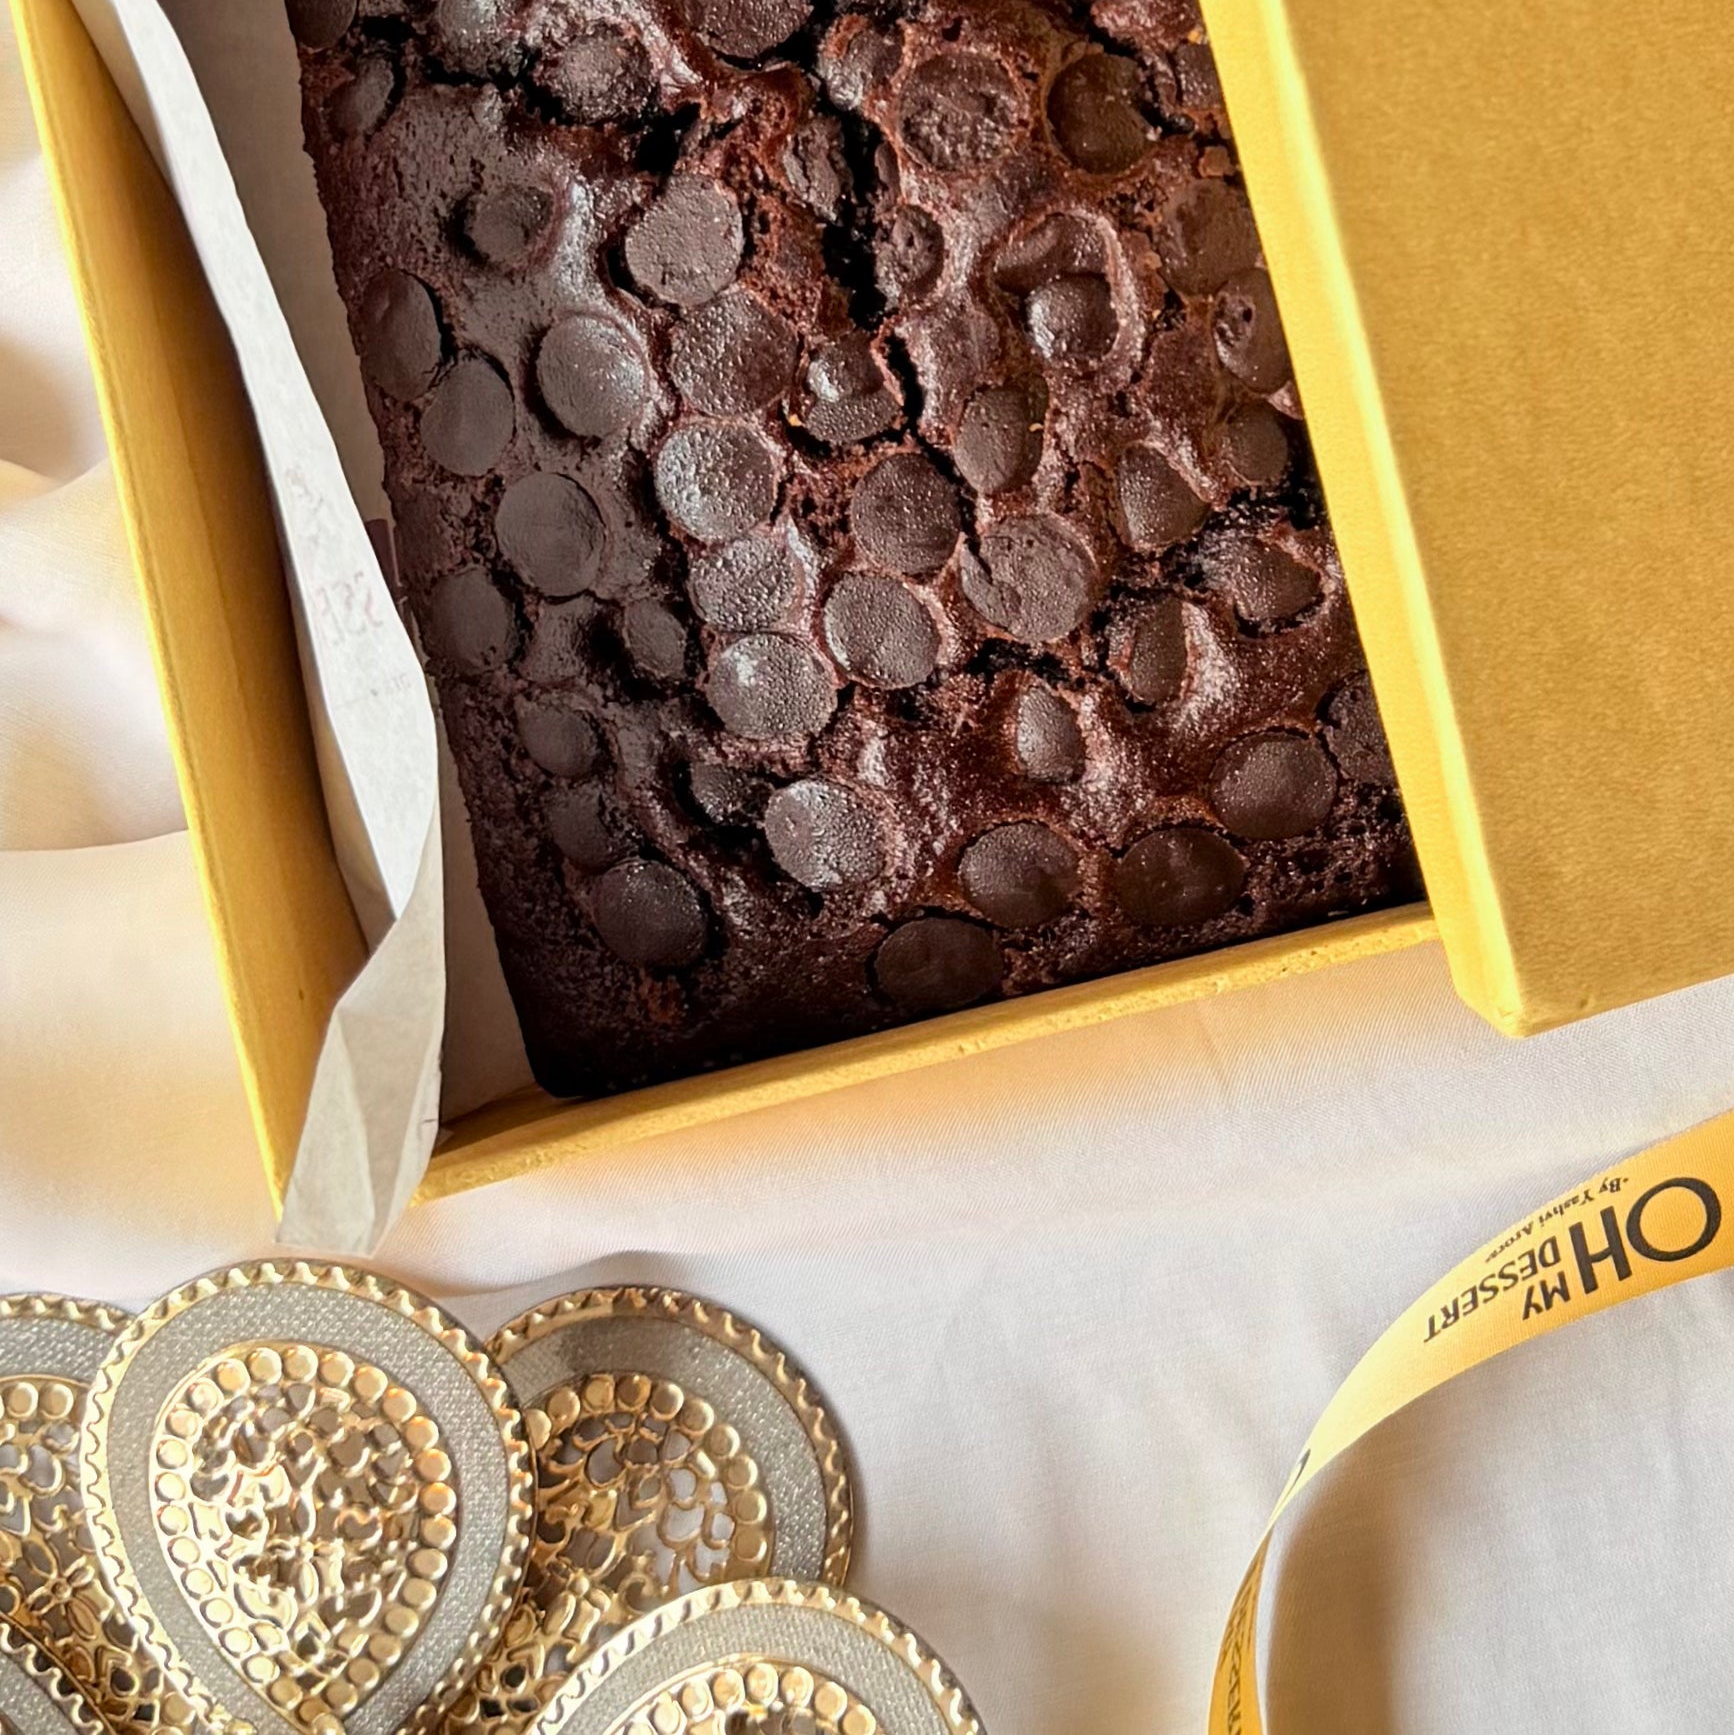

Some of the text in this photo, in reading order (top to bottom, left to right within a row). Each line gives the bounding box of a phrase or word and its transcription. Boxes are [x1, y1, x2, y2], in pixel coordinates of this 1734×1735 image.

[1522, 1177, 1722, 1320] OH MY
[1539, 1190, 1595, 1227] Yashvi
[1423, 1235, 1561, 1343] DESSERT
